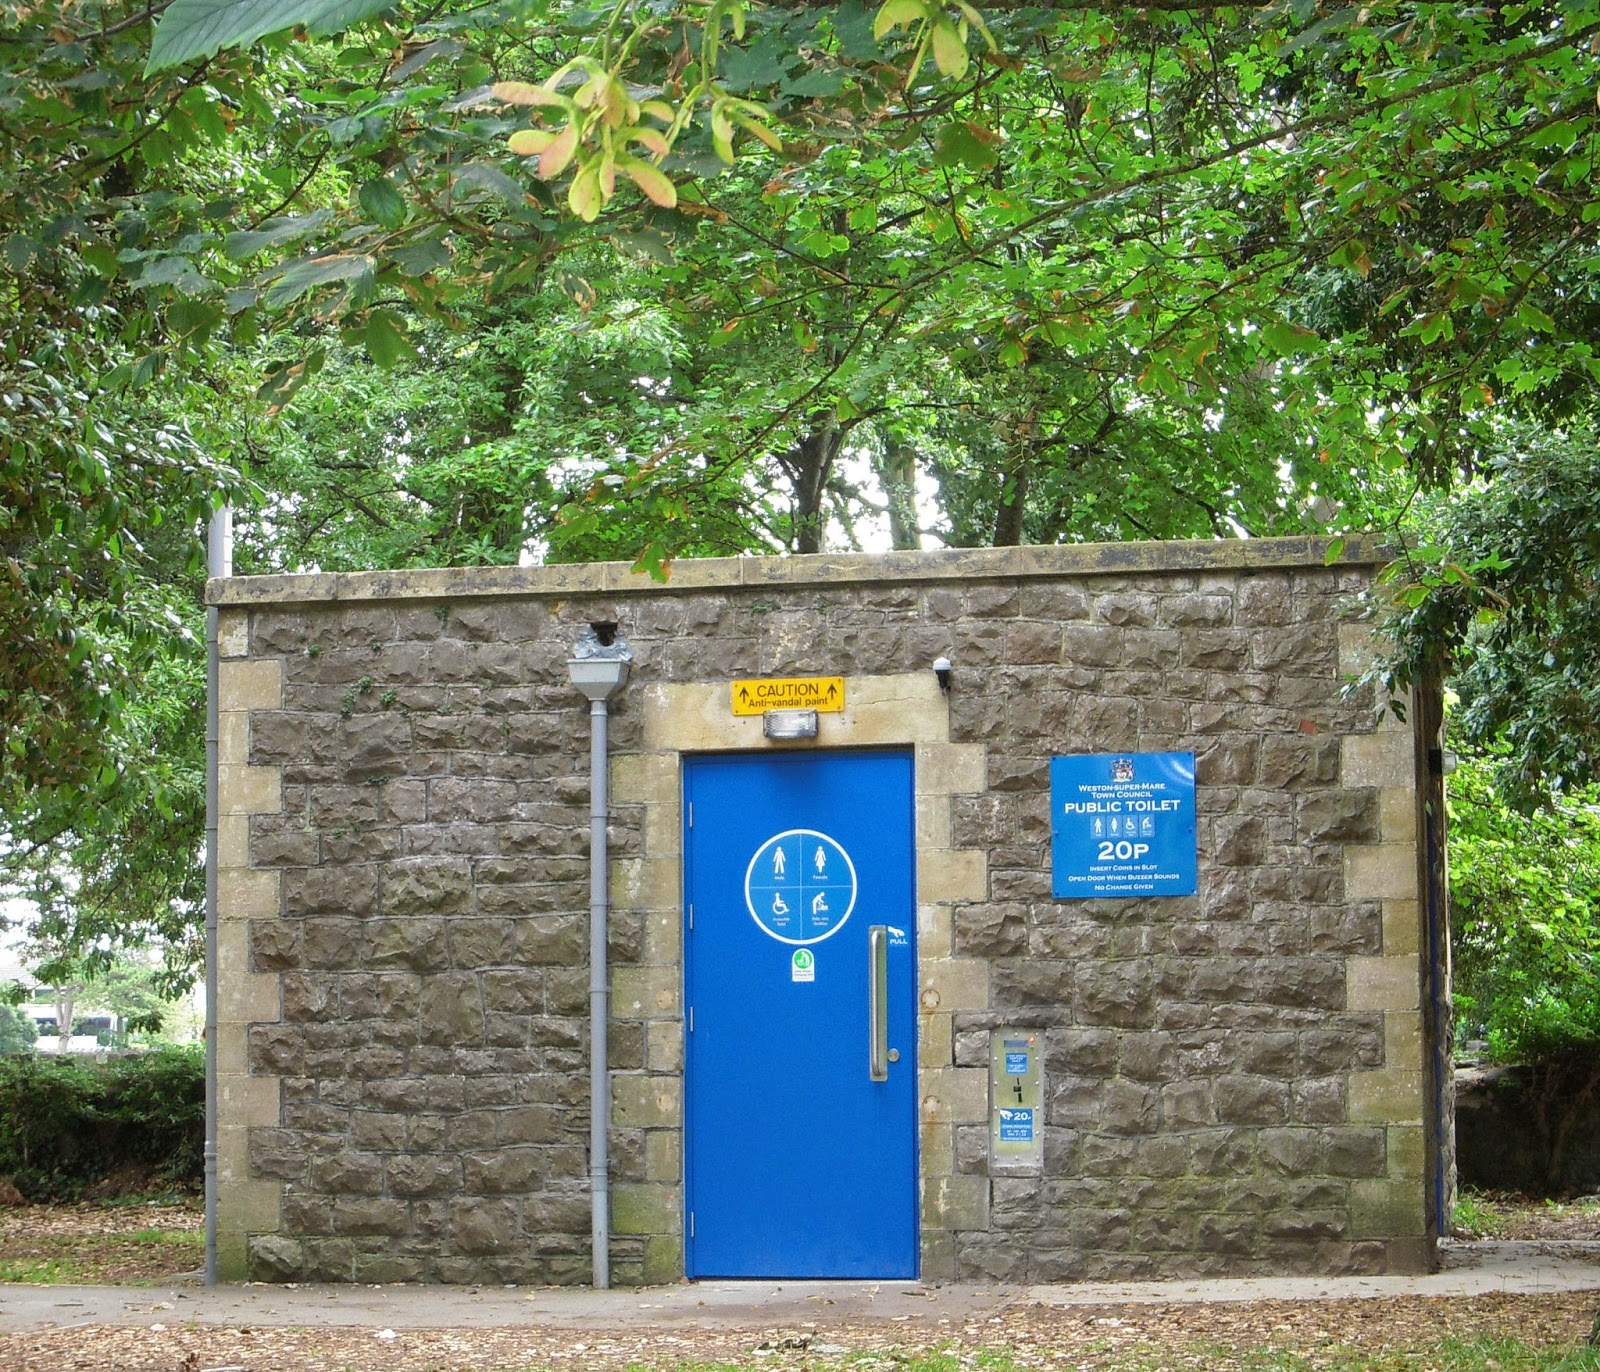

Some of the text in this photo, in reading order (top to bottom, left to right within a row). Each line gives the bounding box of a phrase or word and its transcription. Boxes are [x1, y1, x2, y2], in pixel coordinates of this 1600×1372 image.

[757, 683, 819, 698] CAUTION
[748, 697, 828, 708] Anti-vandal paint
[1078, 783, 1166, 792] WESTON-SUPER-MARE
[1065, 800, 1180, 814] PUBLIC TOILET
[1097, 840, 1149, 860] 20P
